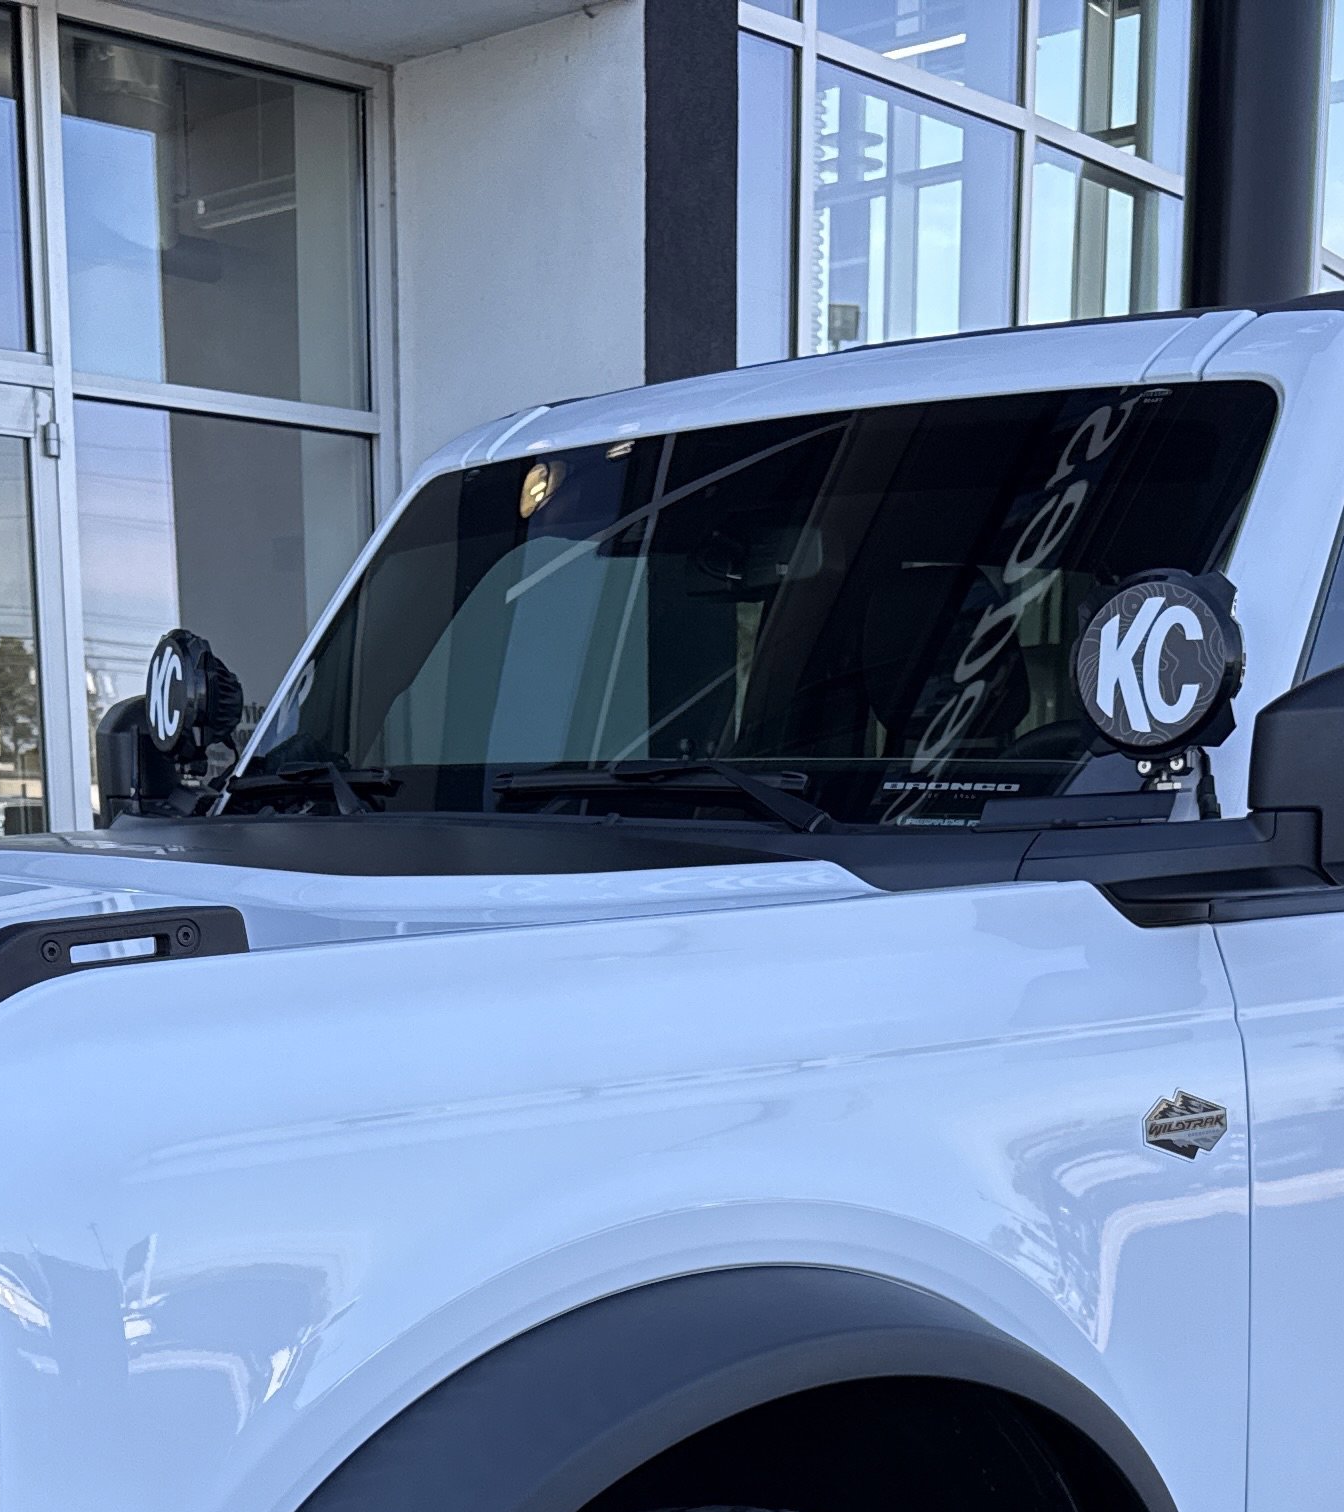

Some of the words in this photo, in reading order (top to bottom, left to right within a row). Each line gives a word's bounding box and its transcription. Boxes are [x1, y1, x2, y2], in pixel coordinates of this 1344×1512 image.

[149, 646, 183, 741] KC
[1096, 596, 1204, 733] KC
[882, 781, 1021, 792] BRONCO
[1148, 1113, 1225, 1137] WILDTRAK
